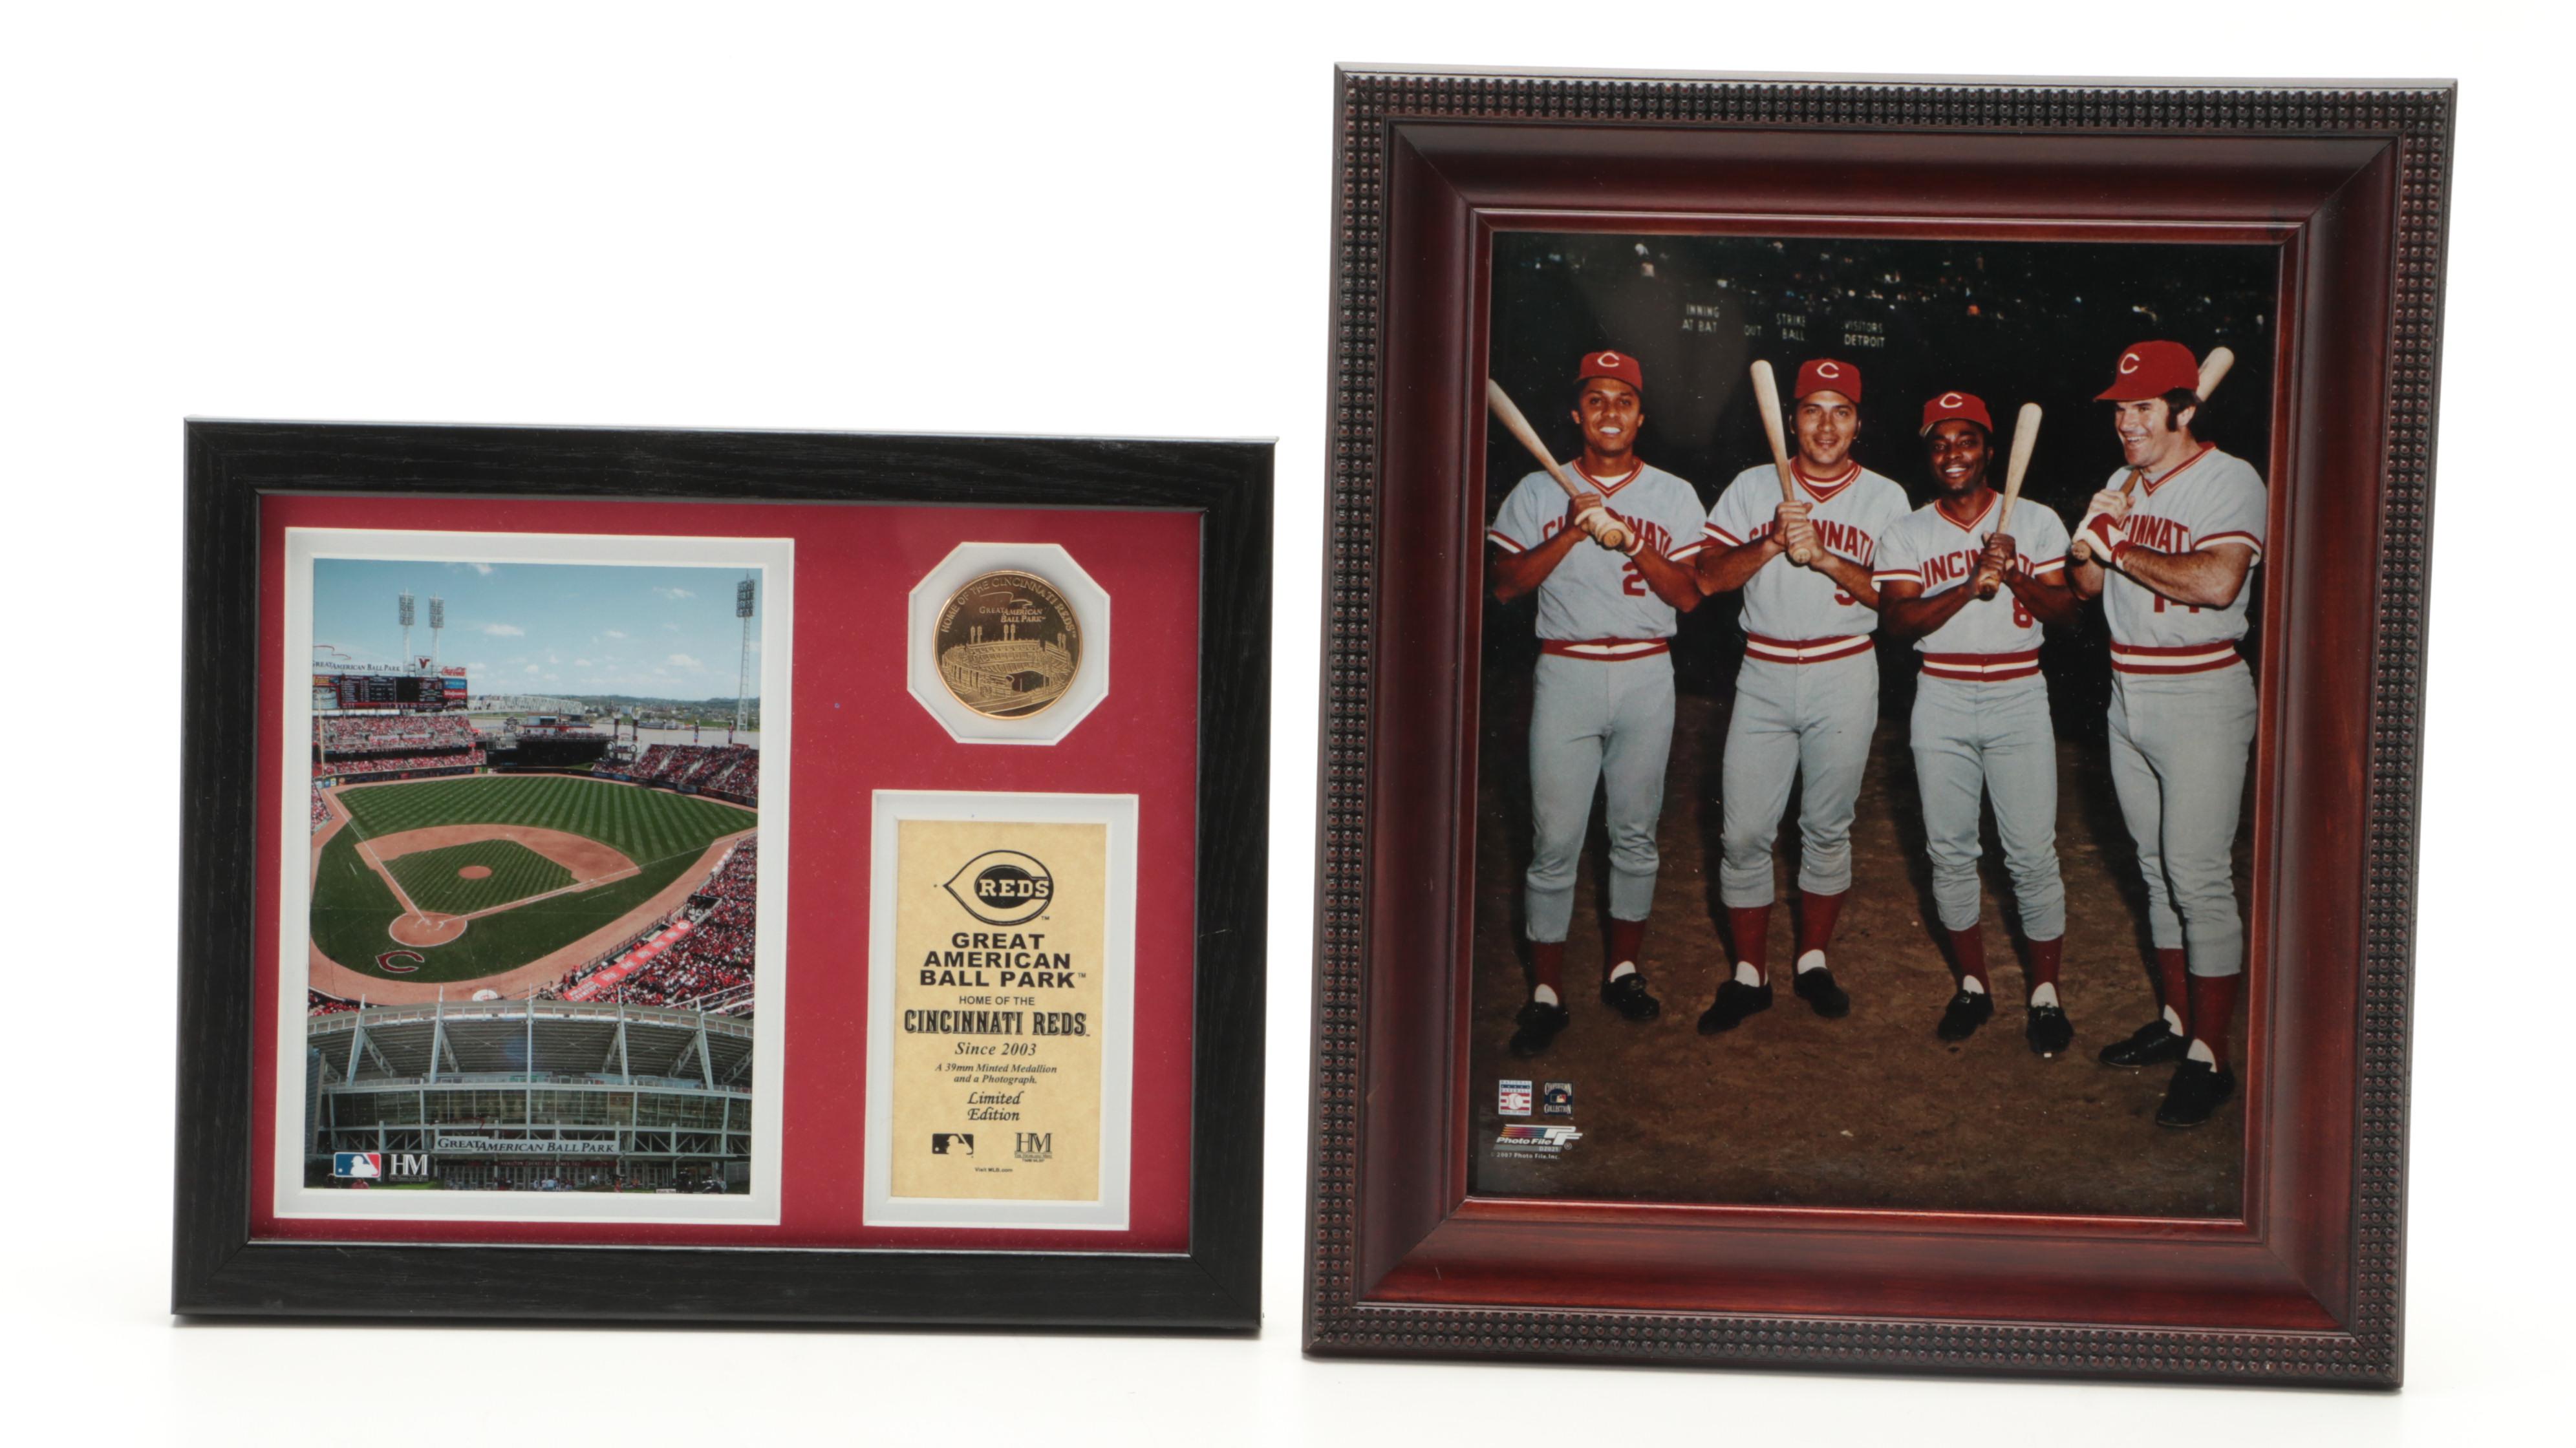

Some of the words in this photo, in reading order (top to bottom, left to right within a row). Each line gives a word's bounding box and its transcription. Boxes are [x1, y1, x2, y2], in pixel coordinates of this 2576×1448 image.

[1686, 304, 1720, 318] INNING
[1682, 319, 1693, 330] AT
[1698, 320, 1717, 332] BAT
[1776, 313, 1806, 327] STRIKE
[1845, 321, 1883, 334] VISITORS
[1744, 325, 1762, 336] OUT
[1782, 328, 1805, 341] BALL
[1845, 334, 1885, 348] DETROIT
[1597, 352, 1620, 367] C
[2120, 353, 2140, 374] C
[1816, 362, 1840, 378] C
[1939, 392, 1962, 409] C
[941, 604, 961, 633] HOME
[957, 592, 971, 606] OF
[971, 581, 990, 595] THE
[992, 577, 1056, 606] CINCINNATI
[979, 879, 1049, 897] REDS
[952, 932, 1045, 950] GREAT
[923, 951, 1071, 970] AMERICAN
[920, 970, 990, 986] BALL
[959, 996, 992, 1005] HOME
[995, 996, 1011, 1005] OF
[1014, 997, 1035, 1006] THE
[905, 1009, 1024, 1035] CINCINNATI
[1033, 1012, 1088, 1037] REDS
[955, 1041, 996, 1056] Since
[1001, 1043, 1037, 1056] 2003
[935, 1063, 943, 1072] A
[945, 1063, 974, 1072] 39mm
[977, 1063, 1009, 1073] Minted
[1011, 1064, 1057, 1074] Medallion
[954, 1074, 971, 1083] and
[982, 1075, 1037, 1085] Photograph.
[967, 1091, 1025, 1105] Limited
[967, 1107, 1020, 1122] Edition
[547, 1142, 579, 1153] BALL
[582, 1142, 614, 1153] PARK
[1014, 1133, 1053, 1153] HM
[1496, 1136, 1530, 1145] Photo
[389, 1154, 429, 1175] HM
